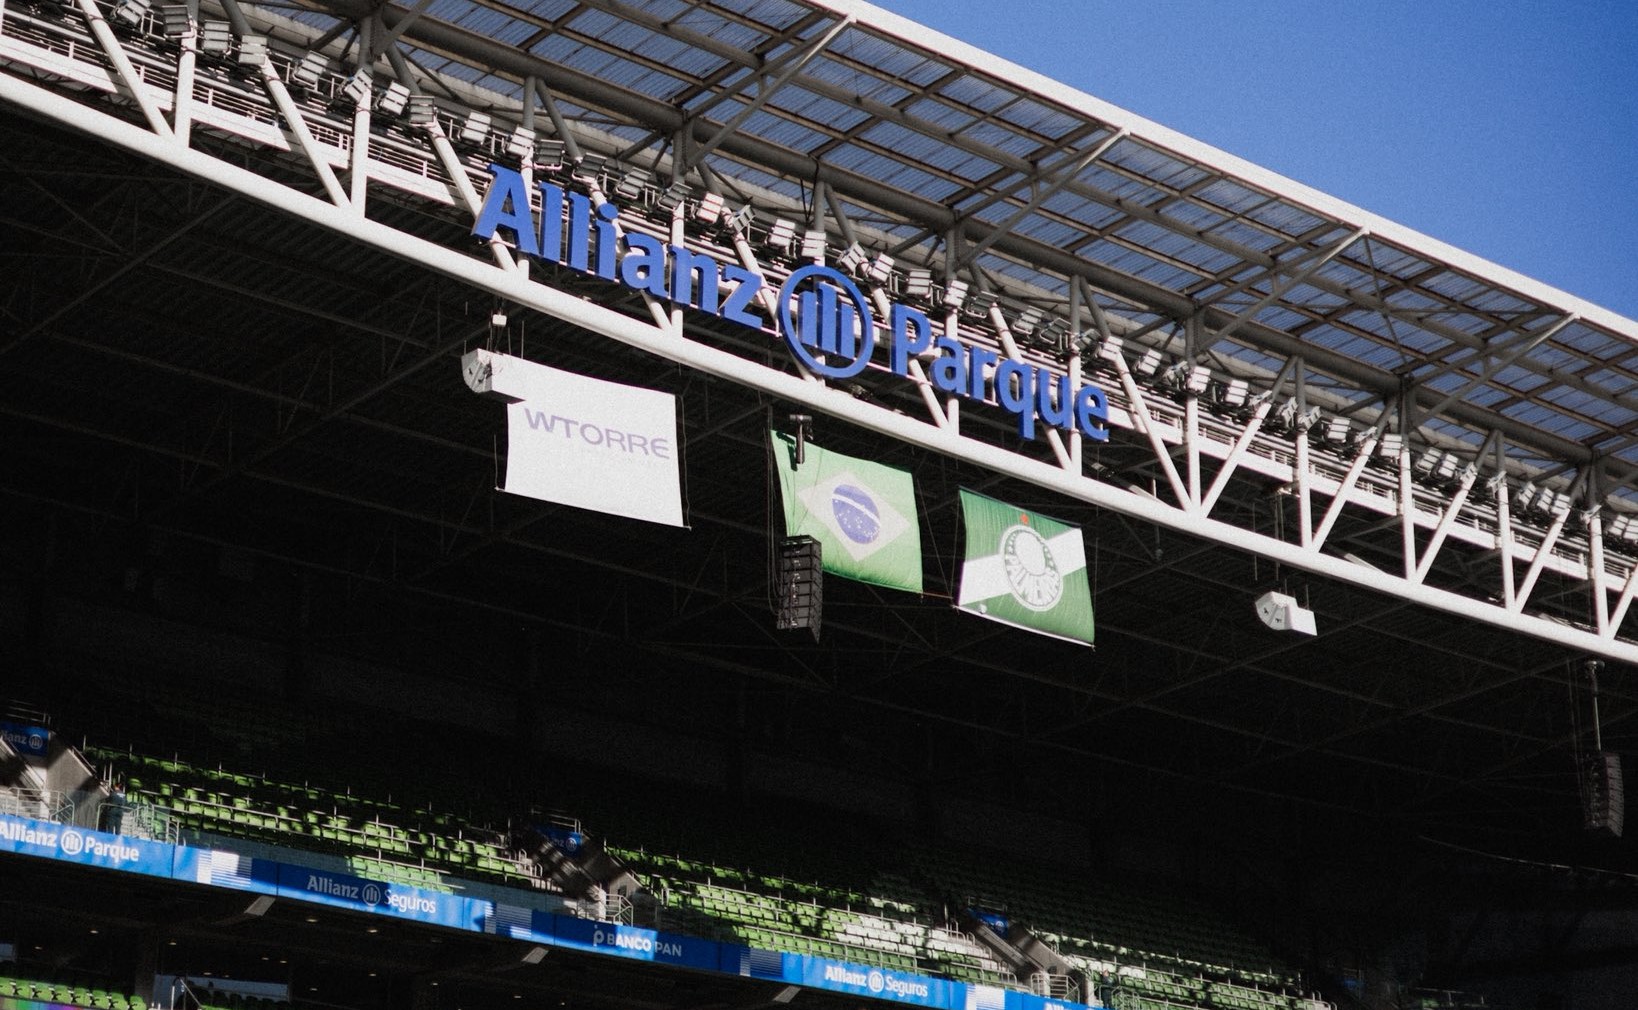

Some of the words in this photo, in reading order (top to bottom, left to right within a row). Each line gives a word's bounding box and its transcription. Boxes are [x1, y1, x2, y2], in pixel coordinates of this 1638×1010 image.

[471, 163, 763, 329] Allianz
[890, 303, 1109, 442] Parque
[524, 407, 670, 460] WTORRE
[0, 821, 57, 848] Allianz
[84, 836, 139, 863] Parque
[307, 875, 359, 899] Allianz
[384, 889, 436, 914] Seguros
[607, 933, 652, 952] BANCO
[654, 941, 682, 957] PAN
[825, 965, 867, 987] Allianz
[886, 976, 928, 997] Seguros
